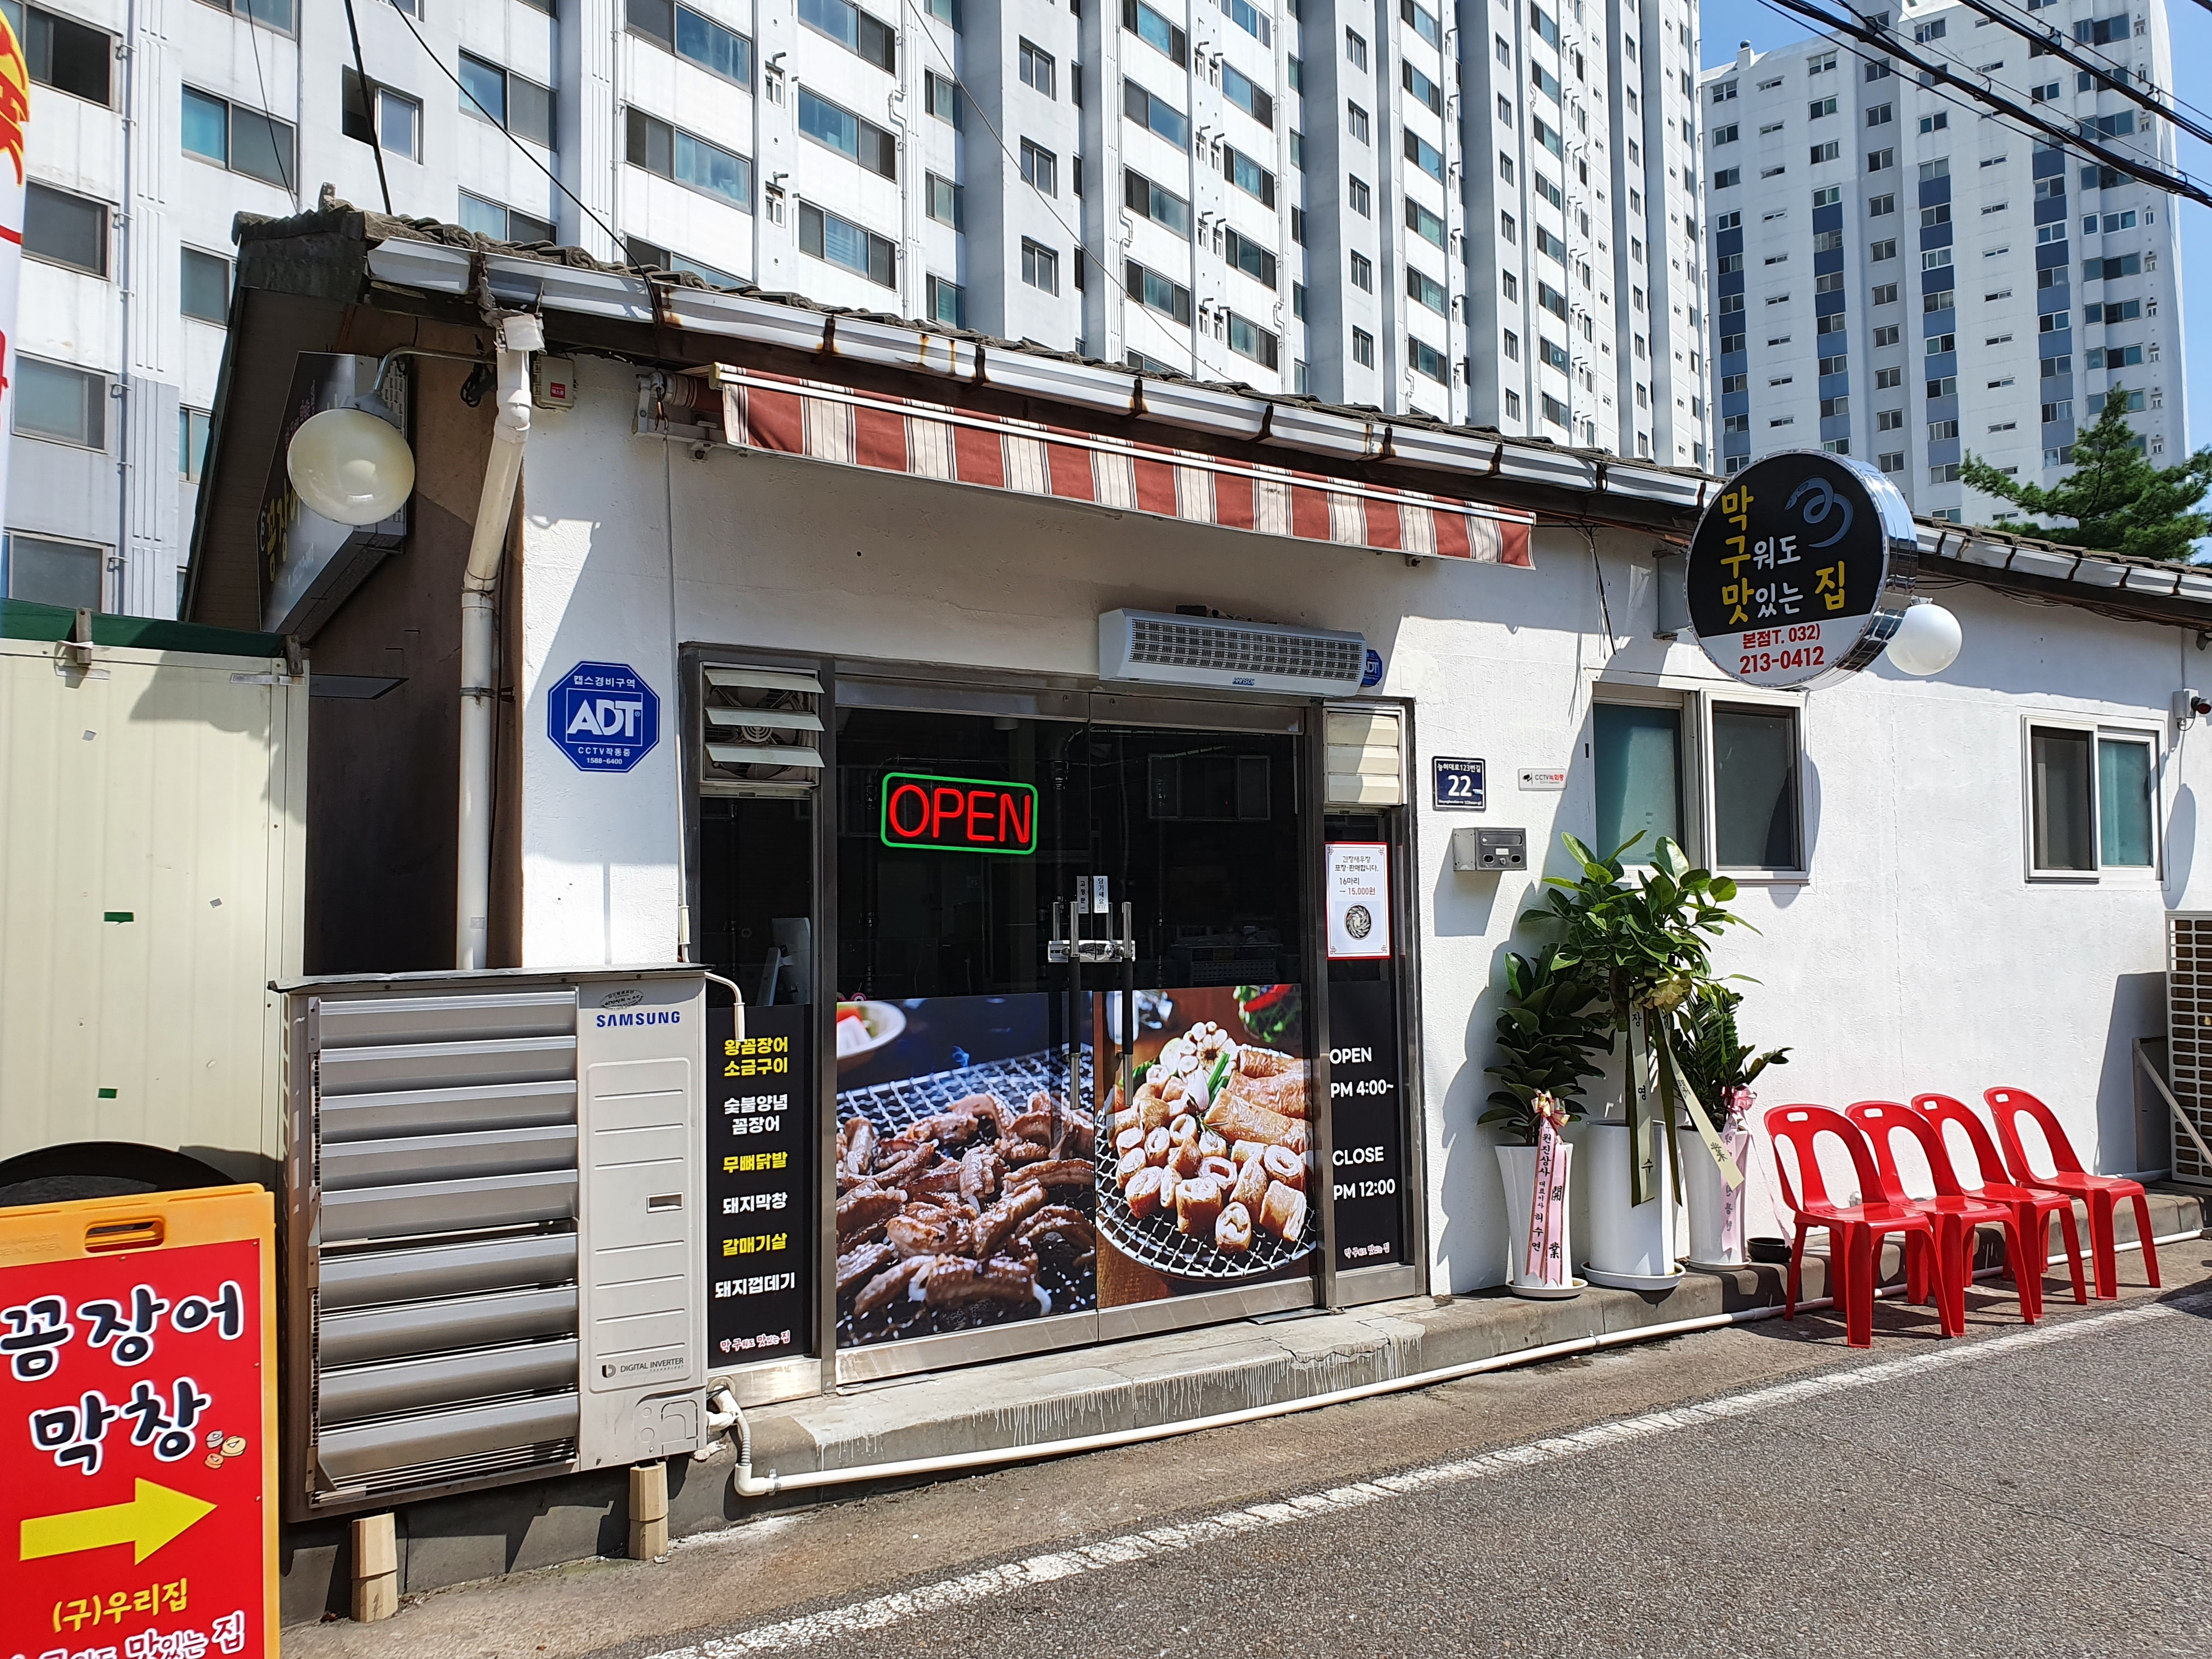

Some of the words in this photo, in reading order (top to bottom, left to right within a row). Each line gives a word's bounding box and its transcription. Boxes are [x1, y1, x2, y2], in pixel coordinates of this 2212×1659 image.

[1722, 485, 1754, 531] 막
[1720, 535, 1801, 579] 구워도
[1722, 578, 1803, 625] 맛있는
[1815, 560, 1846, 611] 집
[1742, 629, 1784, 650] 본점T.
[1788, 623, 1821, 643] 032)
[1365, 661, 1379, 673] DT
[1740, 646, 1824, 674] 213-0412
[574, 675, 635, 689] 캡스경비구역
[567, 699, 641, 737] ADT
[1448, 775, 1472, 797] 22
[890, 785, 1030, 843] OPEN
[1339, 877, 1359, 885] 16마리
[1348, 887, 1375, 895] 15,000원
[596, 1011, 680, 1028] SAMSUNG
[724, 1036, 788, 1056] 왕꼼장어
[1329, 1046, 1372, 1064] OPEN
[724, 1057, 788, 1077] 소금구이
[1330, 1082, 1353, 1098] PM
[1356, 1079, 1394, 1096] 4:00~
[724, 1093, 788, 1115] 숯불양념
[732, 1115, 780, 1135] 꼼장어
[723, 1152, 788, 1173] 무뼈닭발
[1332, 1146, 1384, 1166] CLOSE
[1333, 1183, 1356, 1200] PM
[1359, 1178, 1396, 1198] 12:00
[1537, 1181, 1545, 1209] 대표이사
[723, 1192, 787, 1215] 돼지막창
[1532, 1212, 1543, 1252] 허수연
[723, 1233, 787, 1256] 갈매기살
[1383, 1242, 1390, 1254] 집
[715, 1272, 795, 1299] 돼지껍데기
[0, 1279, 244, 1381] 꼼장어
[720, 1339, 731, 1353] 막
[731, 1338, 756, 1352] 구워도
[756, 1333, 780, 1348] 맛있는
[781, 1329, 791, 1344] 집
[620, 1363, 648, 1373] DIGITAL
[650, 1357, 684, 1368] INVERTER
[29, 1376, 212, 1476] 막창
[53, 1577, 187, 1633] (구)우리집
[125, 1628, 208, 1659] 맛있는
[212, 1610, 245, 1655] 집
